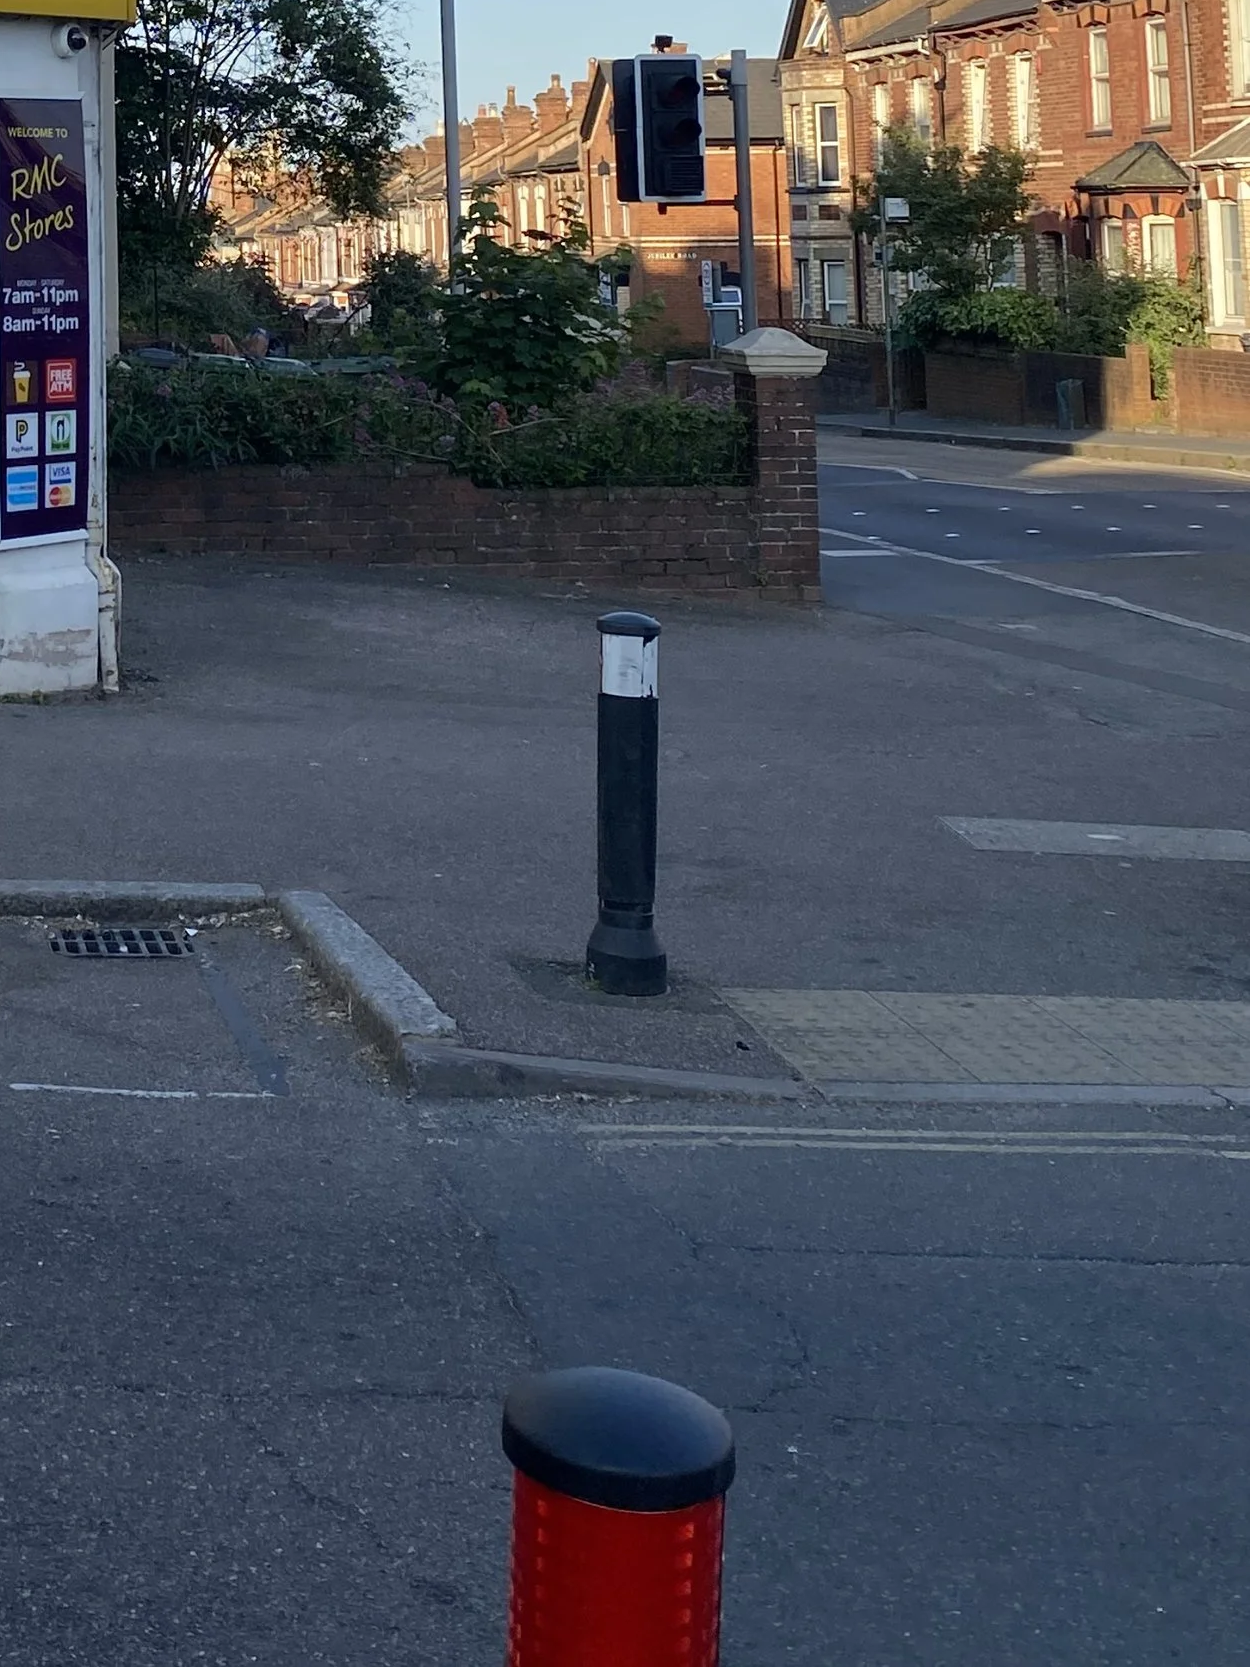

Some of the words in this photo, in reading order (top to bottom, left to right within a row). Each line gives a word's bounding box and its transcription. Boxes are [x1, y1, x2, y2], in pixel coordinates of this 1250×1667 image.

[8, 127, 53, 138] WELCOME
[56, 128, 68, 138] TO
[10, 153, 68, 201] RMC
[5, 205, 74, 251] Stores
[2, 286, 79, 306] 7am-11pm
[2, 314, 79, 333] 8am-11pm
[50, 369, 72, 382] FREE
[50, 381, 72, 393] ATM
[52, 466, 71, 477] VISA
